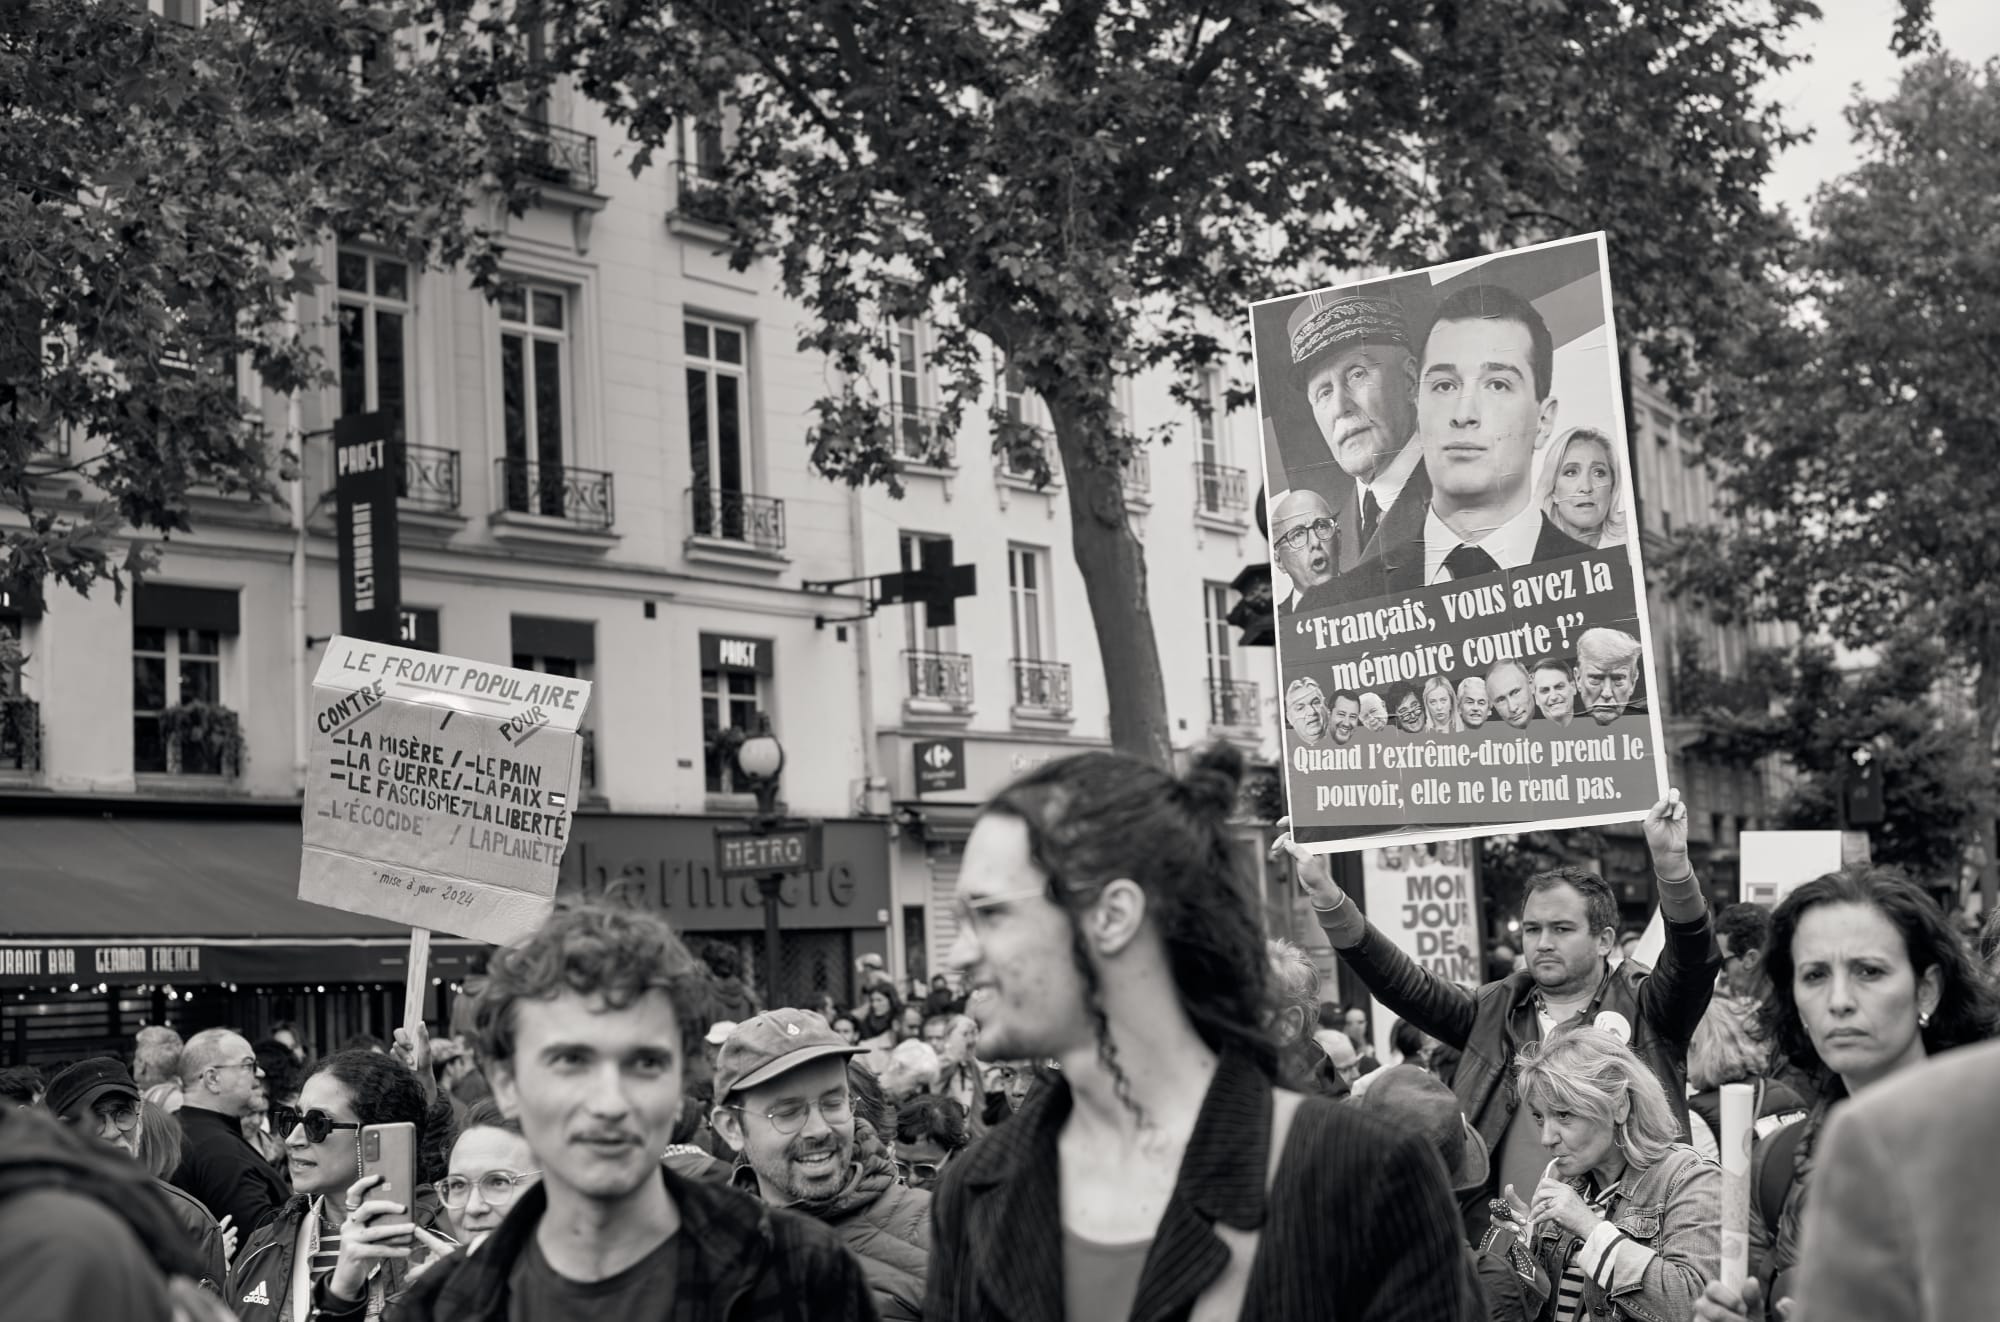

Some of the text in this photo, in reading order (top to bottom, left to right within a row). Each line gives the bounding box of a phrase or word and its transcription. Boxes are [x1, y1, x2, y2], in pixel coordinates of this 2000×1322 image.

[1441, 583, 1507, 623] vous
[1512, 568, 1577, 609] avez
[1581, 560, 1614, 595] la
[343, 651, 580, 711] LE FRONT POPULAIRE
[1332, 643, 1456, 691] mémoire
[1462, 622, 1552, 667] courte
[317, 678, 387, 733] CONTRE
[499, 705, 548, 742] POUR
[379, 736, 444, 765] MISÈRE
[500, 759, 542, 787] PAIN
[1293, 744, 1363, 774] Quand
[1550, 734, 1617, 767] prend
[1622, 734, 1644, 760] le
[378, 757, 452, 790] GUERRE
[500, 782, 543, 809] PAIX
[1316, 774, 1622, 811] pouvoir, elle ne le rend pas.
[376, 779, 460, 816] FASCISME
[495, 810, 567, 840] LIBERTÉ
[725, 837, 802, 867] METRO
[380, 873, 475, 907] mise à jour 2024
[48, 949, 76, 975] BAR
[242, 1294, 270, 1306] adidas
